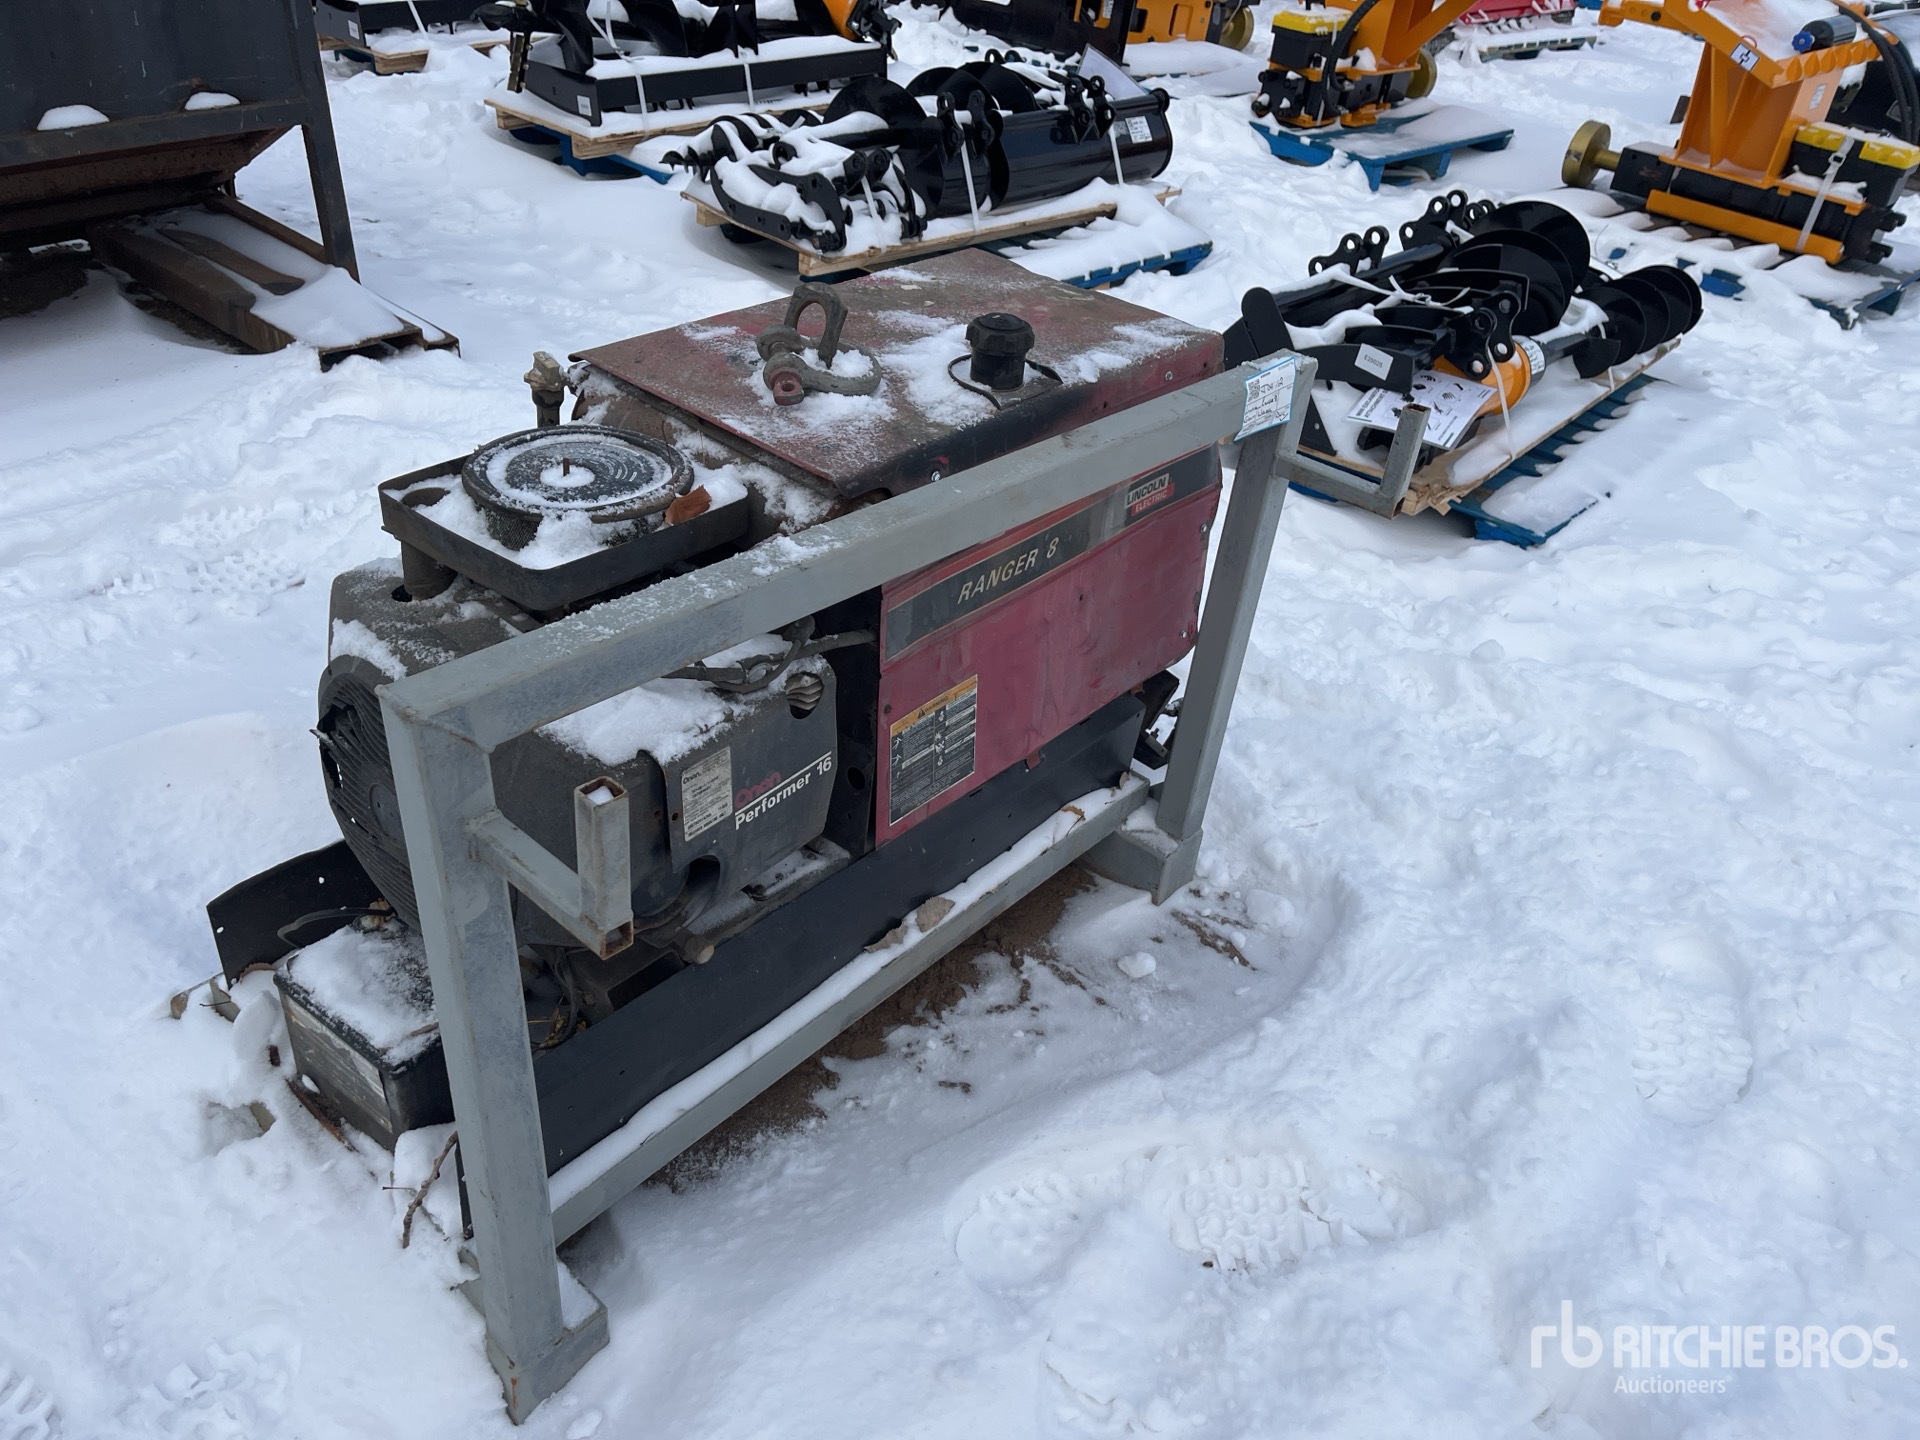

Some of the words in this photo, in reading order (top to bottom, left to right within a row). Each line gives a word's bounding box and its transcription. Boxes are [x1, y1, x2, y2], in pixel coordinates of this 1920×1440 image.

[1126, 476, 1167, 506] LINCOLN
[1134, 490, 1169, 513] ELECTRIC
[957, 548, 1039, 605] RANGER
[1046, 537, 1060, 559] 8
[735, 772, 811, 831] Performer
[816, 756, 832, 776] 16
